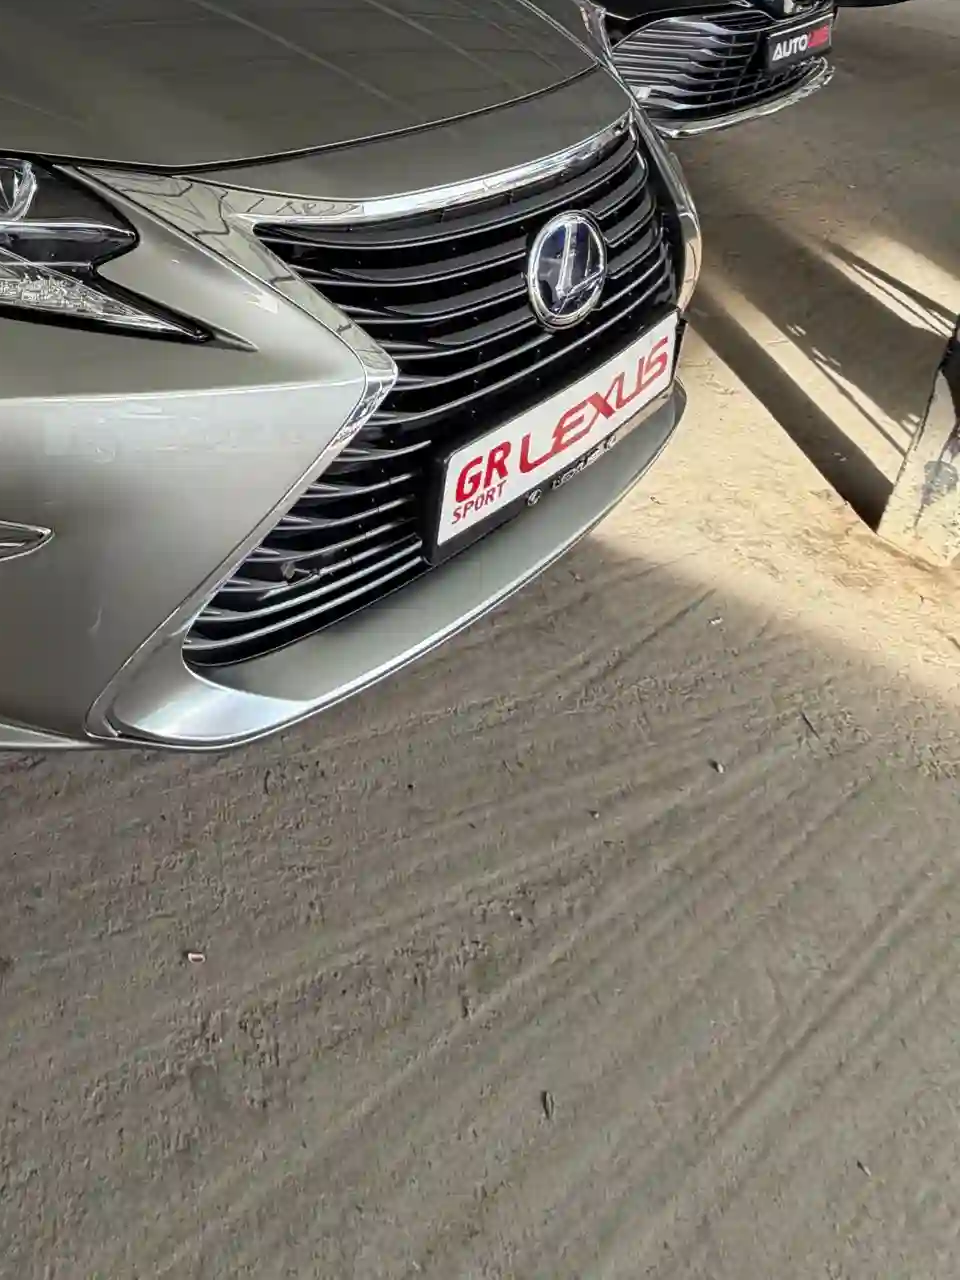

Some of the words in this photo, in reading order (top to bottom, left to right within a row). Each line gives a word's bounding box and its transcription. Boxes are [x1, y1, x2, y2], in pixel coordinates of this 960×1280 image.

[772, 33, 808, 61] AUTO
[455, 441, 512, 503] GR
[519, 336, 669, 474] LEXUS
[451, 480, 508, 525] SPORT
